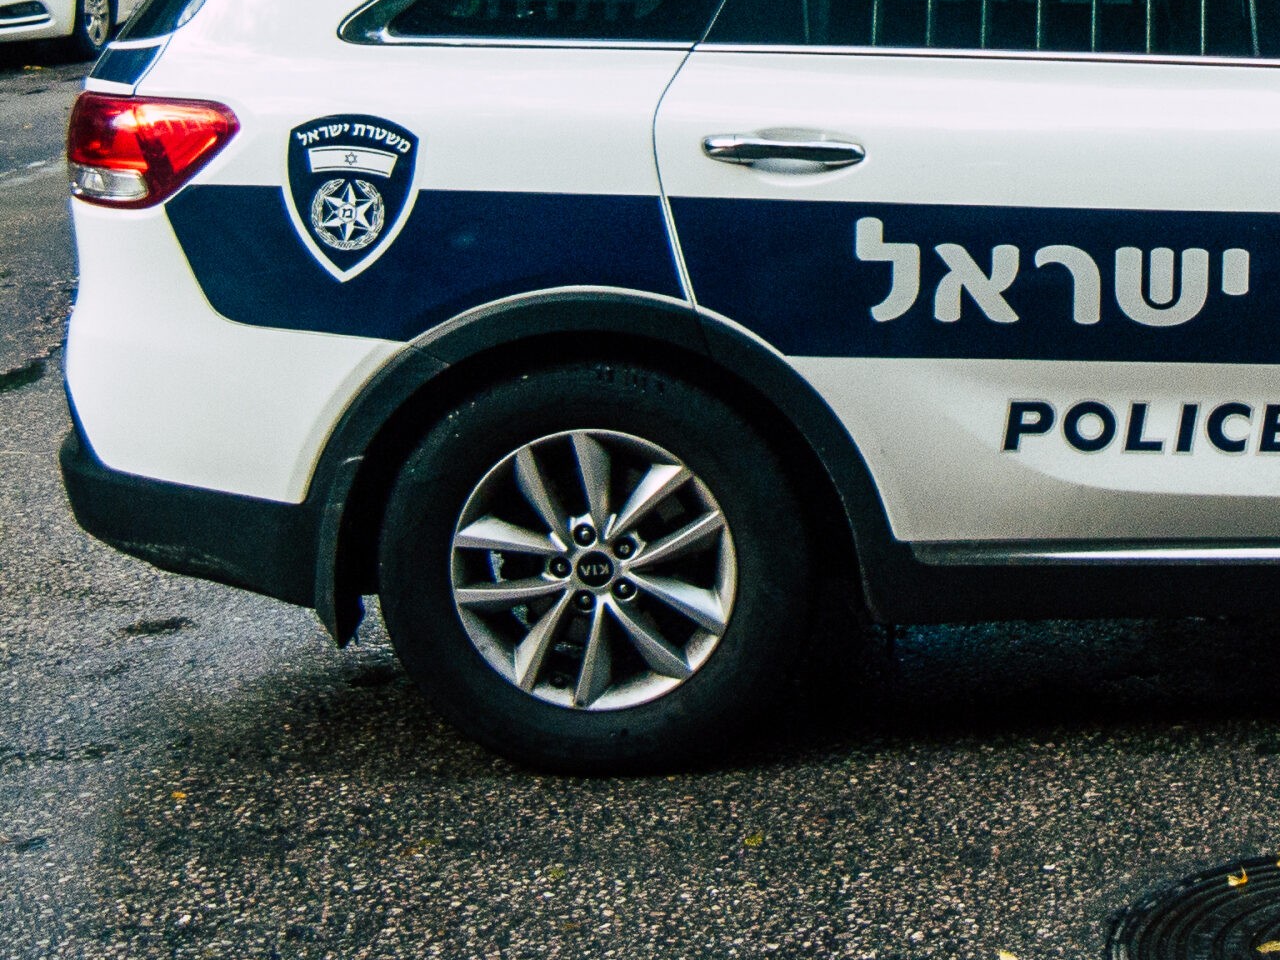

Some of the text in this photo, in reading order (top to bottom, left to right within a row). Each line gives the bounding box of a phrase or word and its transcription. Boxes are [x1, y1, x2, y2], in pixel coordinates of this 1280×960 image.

[297, 123, 411, 153] משטרת ישראל
[855, 217, 1250, 328] ישראל
[579, 563, 611, 577] KIA
